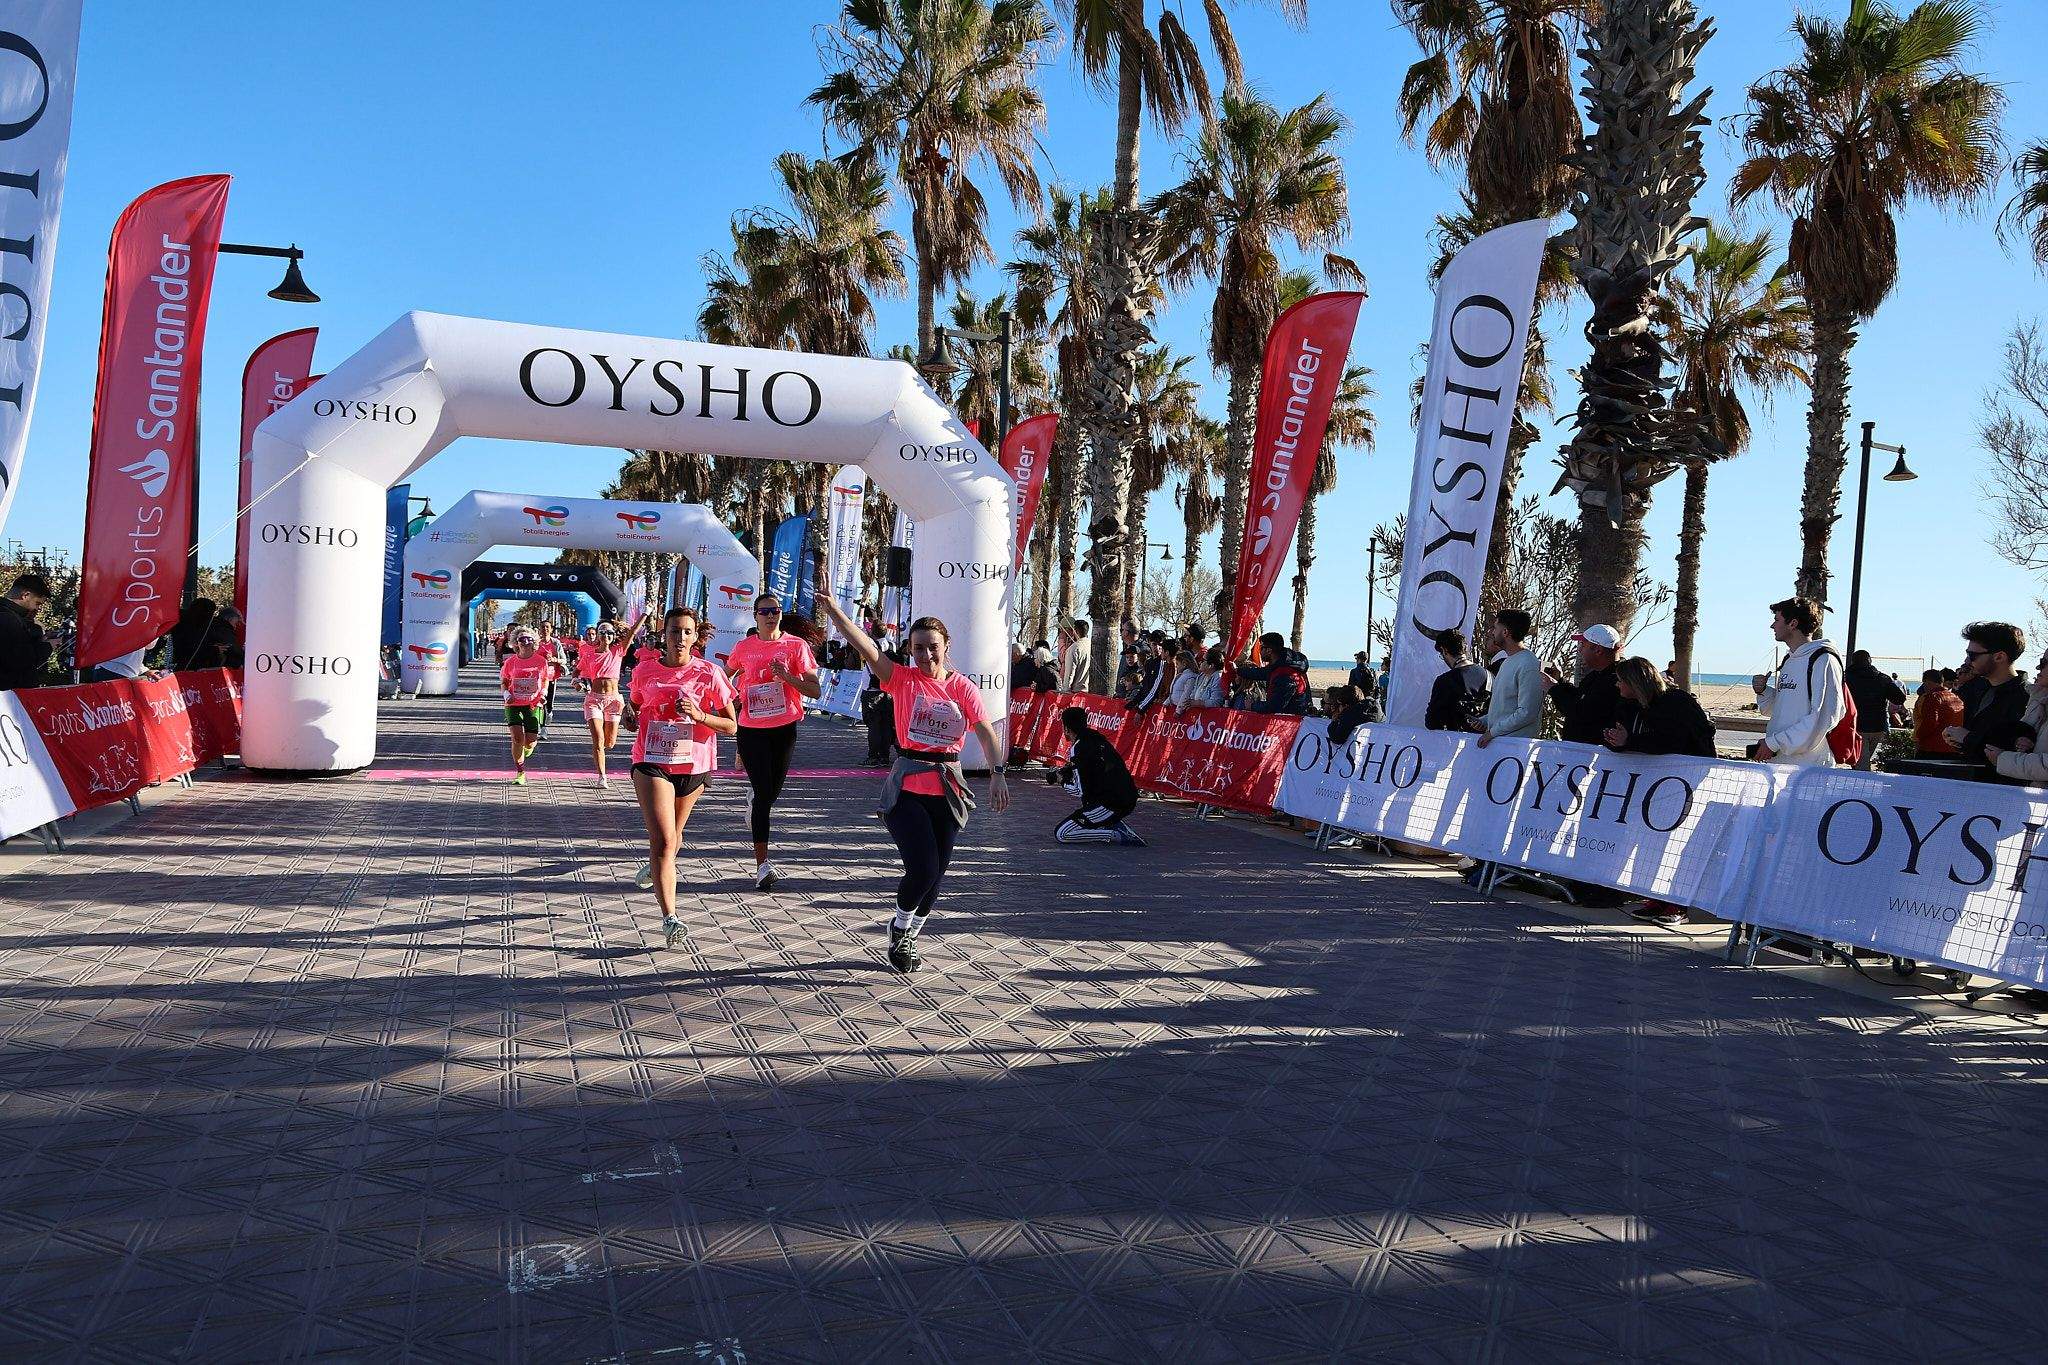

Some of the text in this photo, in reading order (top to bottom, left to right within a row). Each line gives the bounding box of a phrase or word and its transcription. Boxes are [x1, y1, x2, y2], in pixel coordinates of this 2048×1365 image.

[519, 347, 822, 427] OYSHO
[313, 399, 417, 426] OYSHO
[1262, 337, 1324, 512] Santander
[112, 233, 192, 628] Sports Santander
[899, 443, 978, 465] OYSHO
[1413, 294, 1515, 641] OYSHO
[262, 523, 358, 548] OYSHO
[522, 528, 570, 537] TotalEnergies
[616, 533, 661, 542] TotalEnergies
[494, 571, 578, 582] VOLVO
[938, 561, 1009, 581] OYSHO
[410, 591, 451, 599] TotalEnergies
[255, 653, 352, 677] OYSHO
[962, 673, 1005, 690] SHO
[928, 719, 949, 730] 016
[1084, 706, 1126, 731] Santander
[660, 740, 679, 748] 016
[1148, 714, 1280, 753] Sports Santander
[1294, 731, 1423, 789] OYSHO
[1486, 755, 1694, 833] OYSHO
[1817, 798, 2048, 894] OYSH
[1889, 896, 2048, 941] WWW.OYSHO.CO
